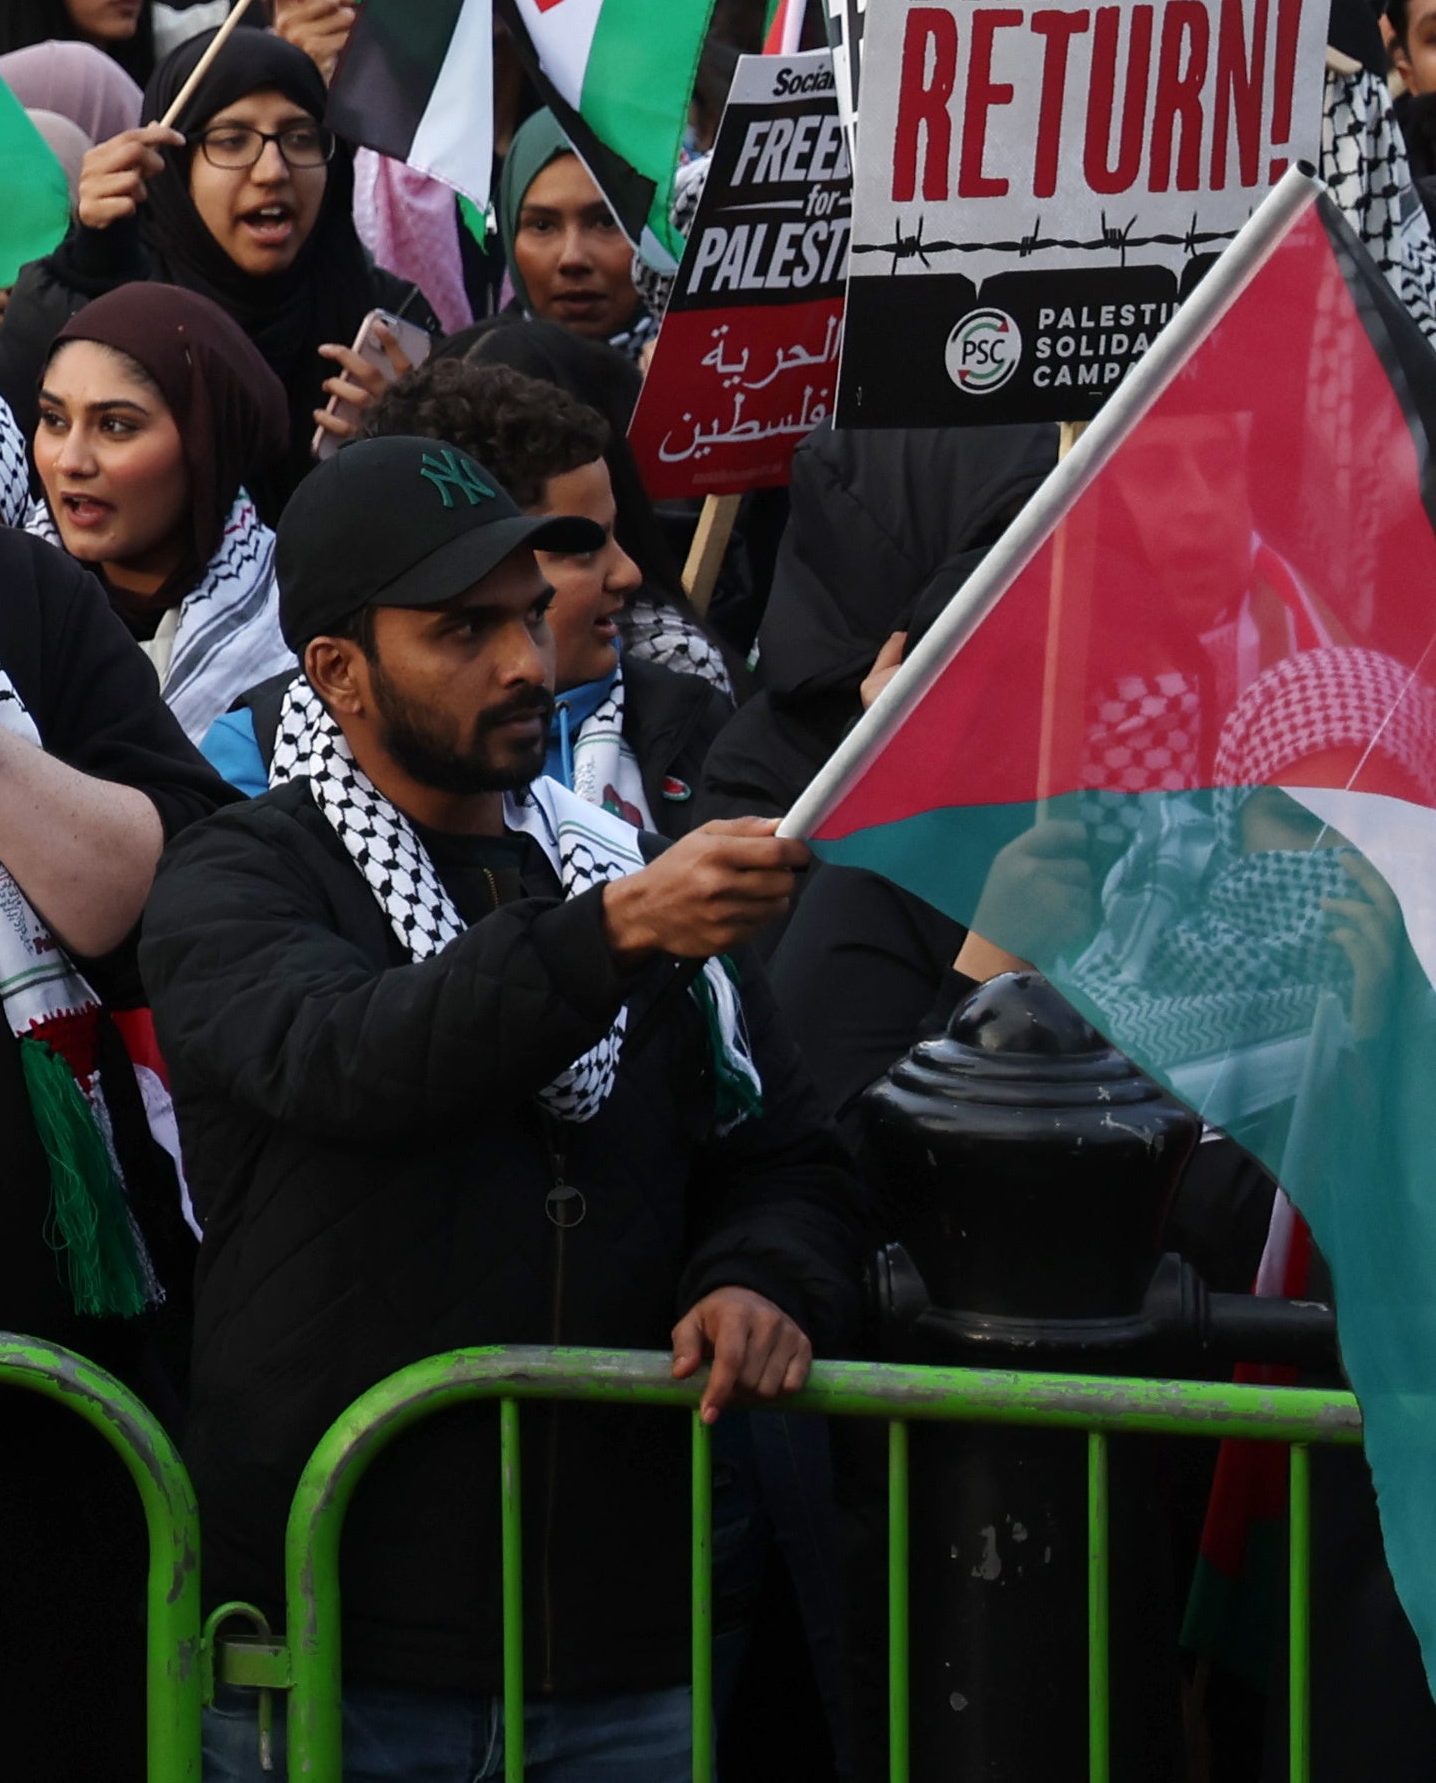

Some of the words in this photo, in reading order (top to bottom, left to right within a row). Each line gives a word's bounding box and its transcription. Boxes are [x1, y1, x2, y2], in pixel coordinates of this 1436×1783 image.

[805, 184, 842, 217] for
[687, 218, 851, 295] PALEST
[960, 338, 1006, 366] PSC
